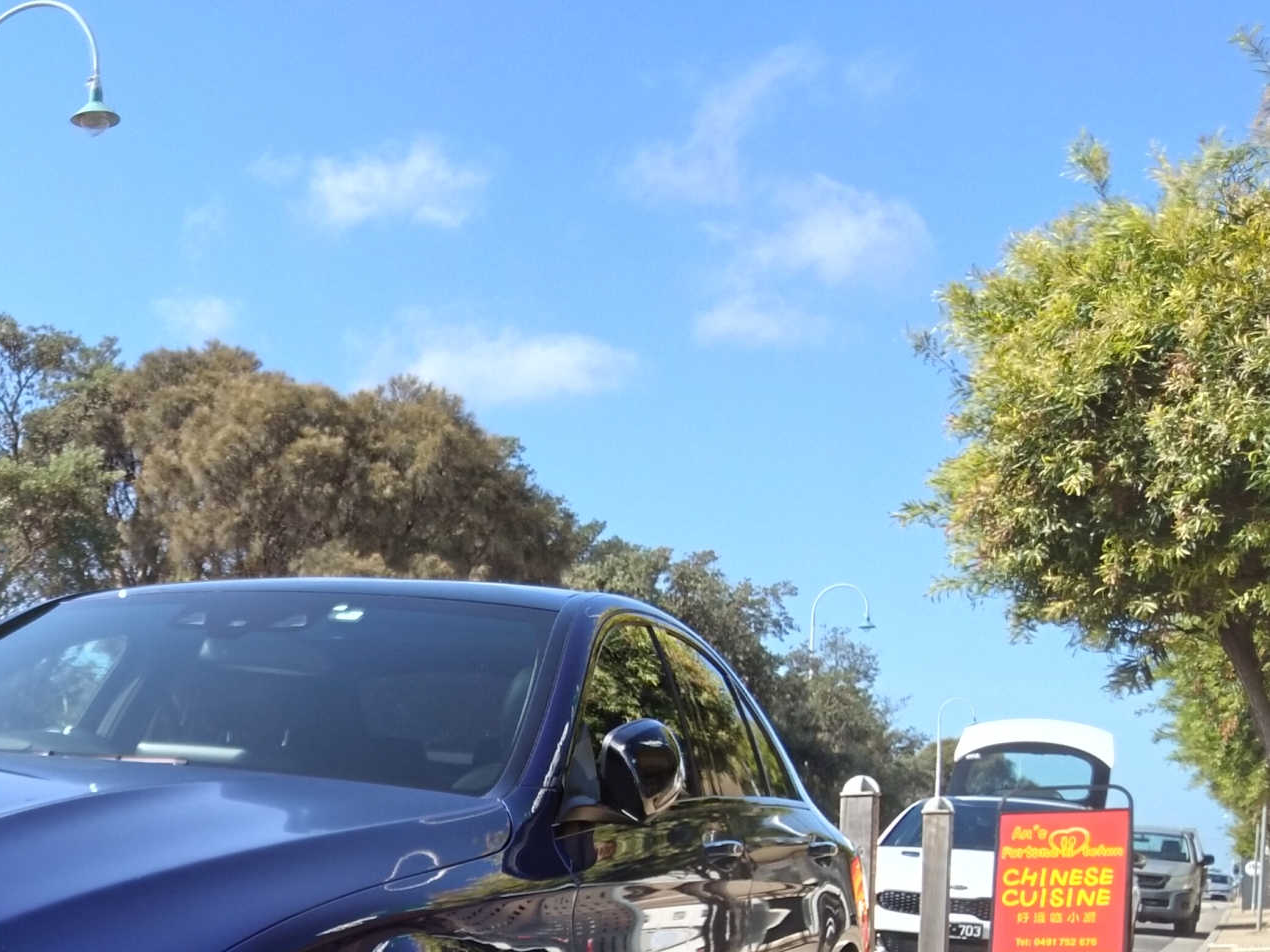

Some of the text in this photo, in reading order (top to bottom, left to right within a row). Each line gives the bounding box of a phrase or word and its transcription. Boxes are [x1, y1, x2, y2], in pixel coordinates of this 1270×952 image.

[1002, 866, 1114, 888] CHINESE
[1001, 887, 1111, 908] CUISINE
[958, 924, 982, 938] 703
[1015, 937, 1032, 947] Tel:
[1034, 937, 1057, 947] 0491
